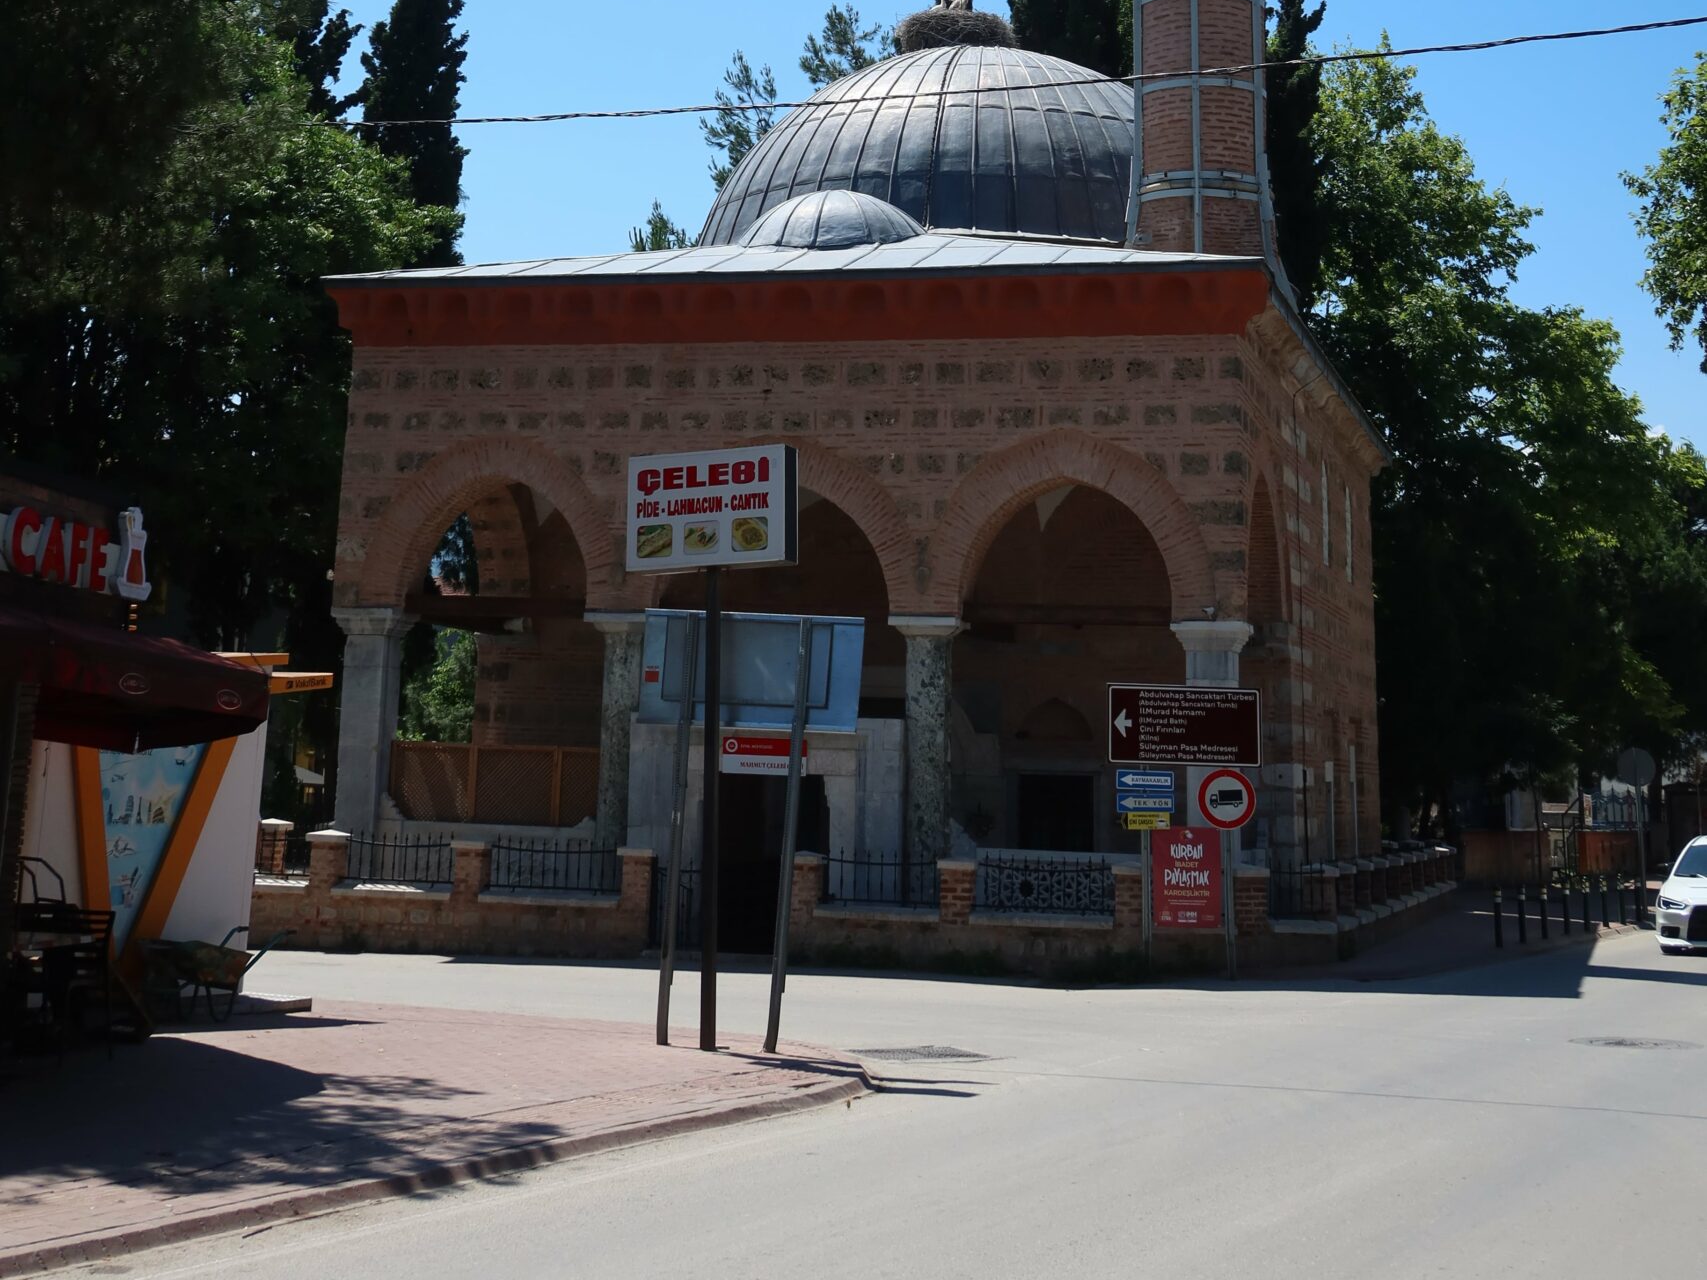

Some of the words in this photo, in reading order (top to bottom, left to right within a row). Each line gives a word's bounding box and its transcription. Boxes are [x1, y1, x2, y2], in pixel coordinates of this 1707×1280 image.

[637, 456, 769, 496] ÇELEBİ
[636, 498, 660, 518] PİDE
[667, 495, 723, 517] LAHMACUN
[730, 492, 769, 511] CANTIK
[9, 506, 112, 592] CAFE
[1139, 690, 1184, 700] Abdulvahap
[1139, 725, 1154, 734] Çini
[1139, 742, 1179, 752] Süleyman
[1180, 743, 1198, 752] Paşa
[1200, 744, 1238, 752] Medresesi
[1170, 842, 1203, 860] KURBAN
[1164, 868, 1210, 888] PAYLAŞMAK
[1163, 889, 1210, 897] KARDEŞLİKTİR
